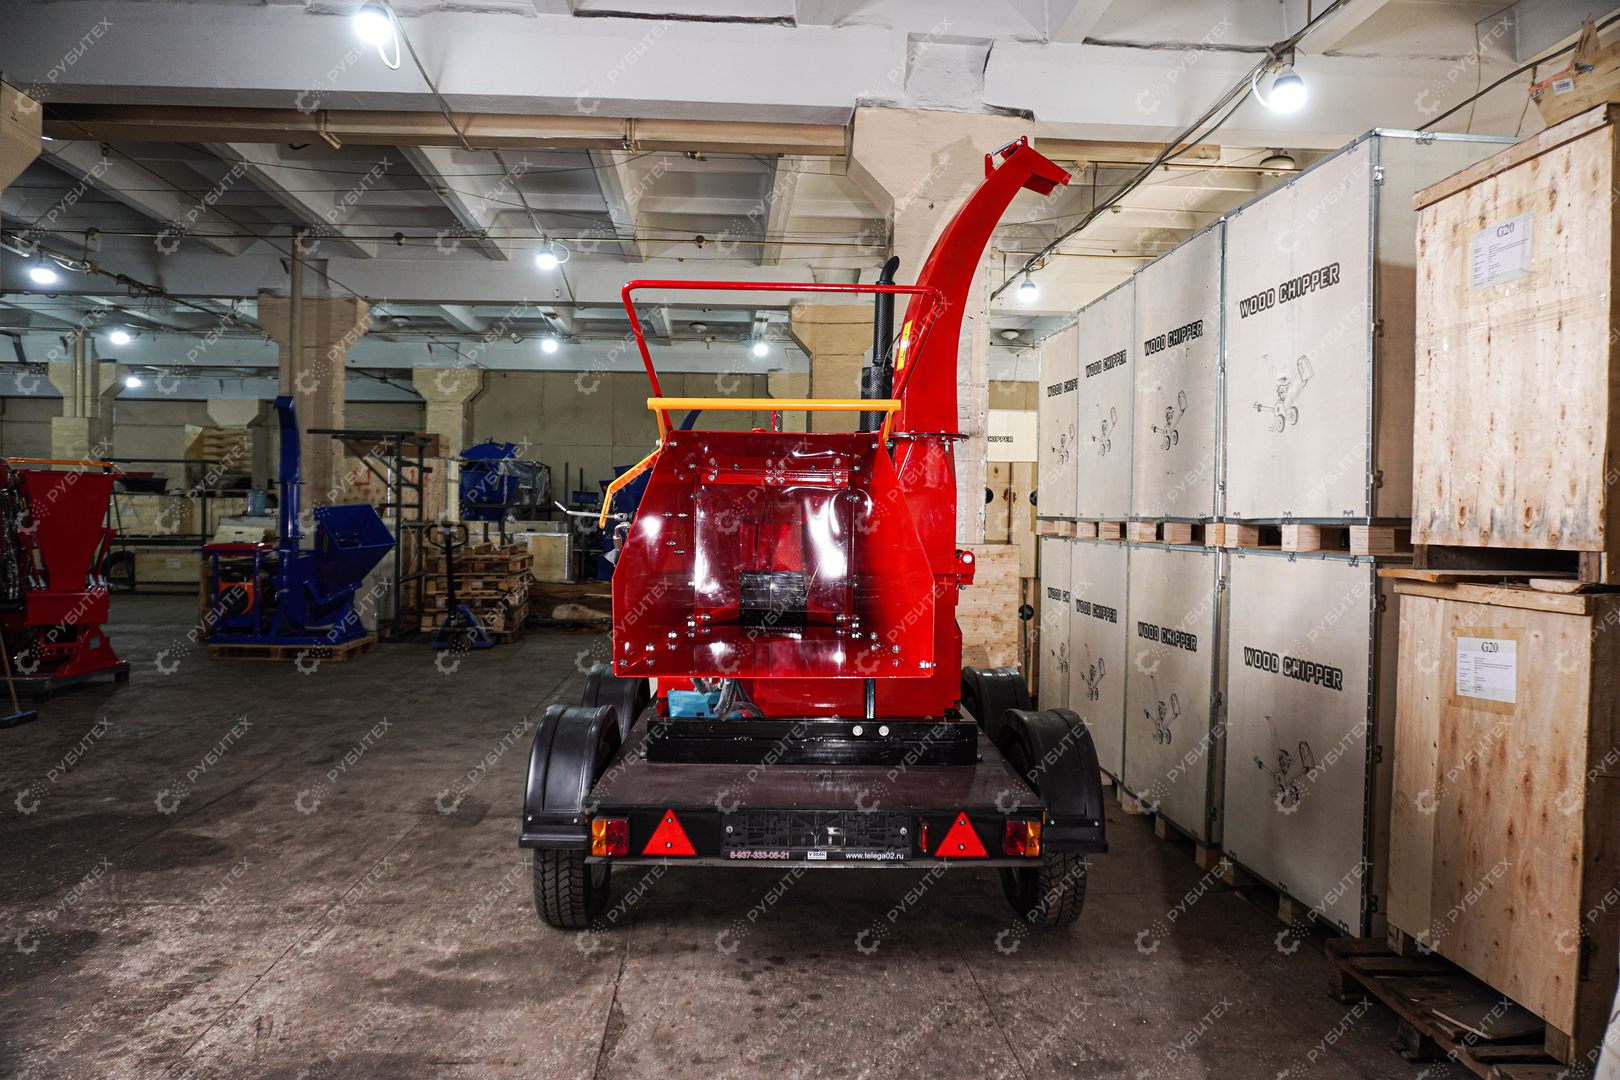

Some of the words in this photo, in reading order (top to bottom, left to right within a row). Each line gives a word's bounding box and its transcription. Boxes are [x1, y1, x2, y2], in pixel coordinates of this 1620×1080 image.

[1497, 222, 1515, 237] G20
[1240, 288, 1275, 319] WOOD
[1279, 262, 1340, 304] CHIPPER
[1144, 334, 1166, 357] WOOD
[1168, 319, 1203, 348] CHIPPER
[1085, 360, 1102, 378] WOOD
[1103, 349, 1127, 371] CHIPPER
[1047, 382, 1063, 397] WOOD
[1047, 587, 1061, 601] WOOD
[1076, 599, 1091, 616] WOOD
[1092, 603, 1117, 624] CHIPPER
[1138, 621, 1159, 642] WOOD
[1161, 627, 1197, 653] CHIPPER
[1481, 641, 1499, 653] G20
[1244, 646, 1279, 674] WOOD
[1283, 656, 1343, 691] CHIPPER
[730, 850, 790, 859] 8-937-333-05-21
[845, 852, 904, 860] www.telega02.ru
